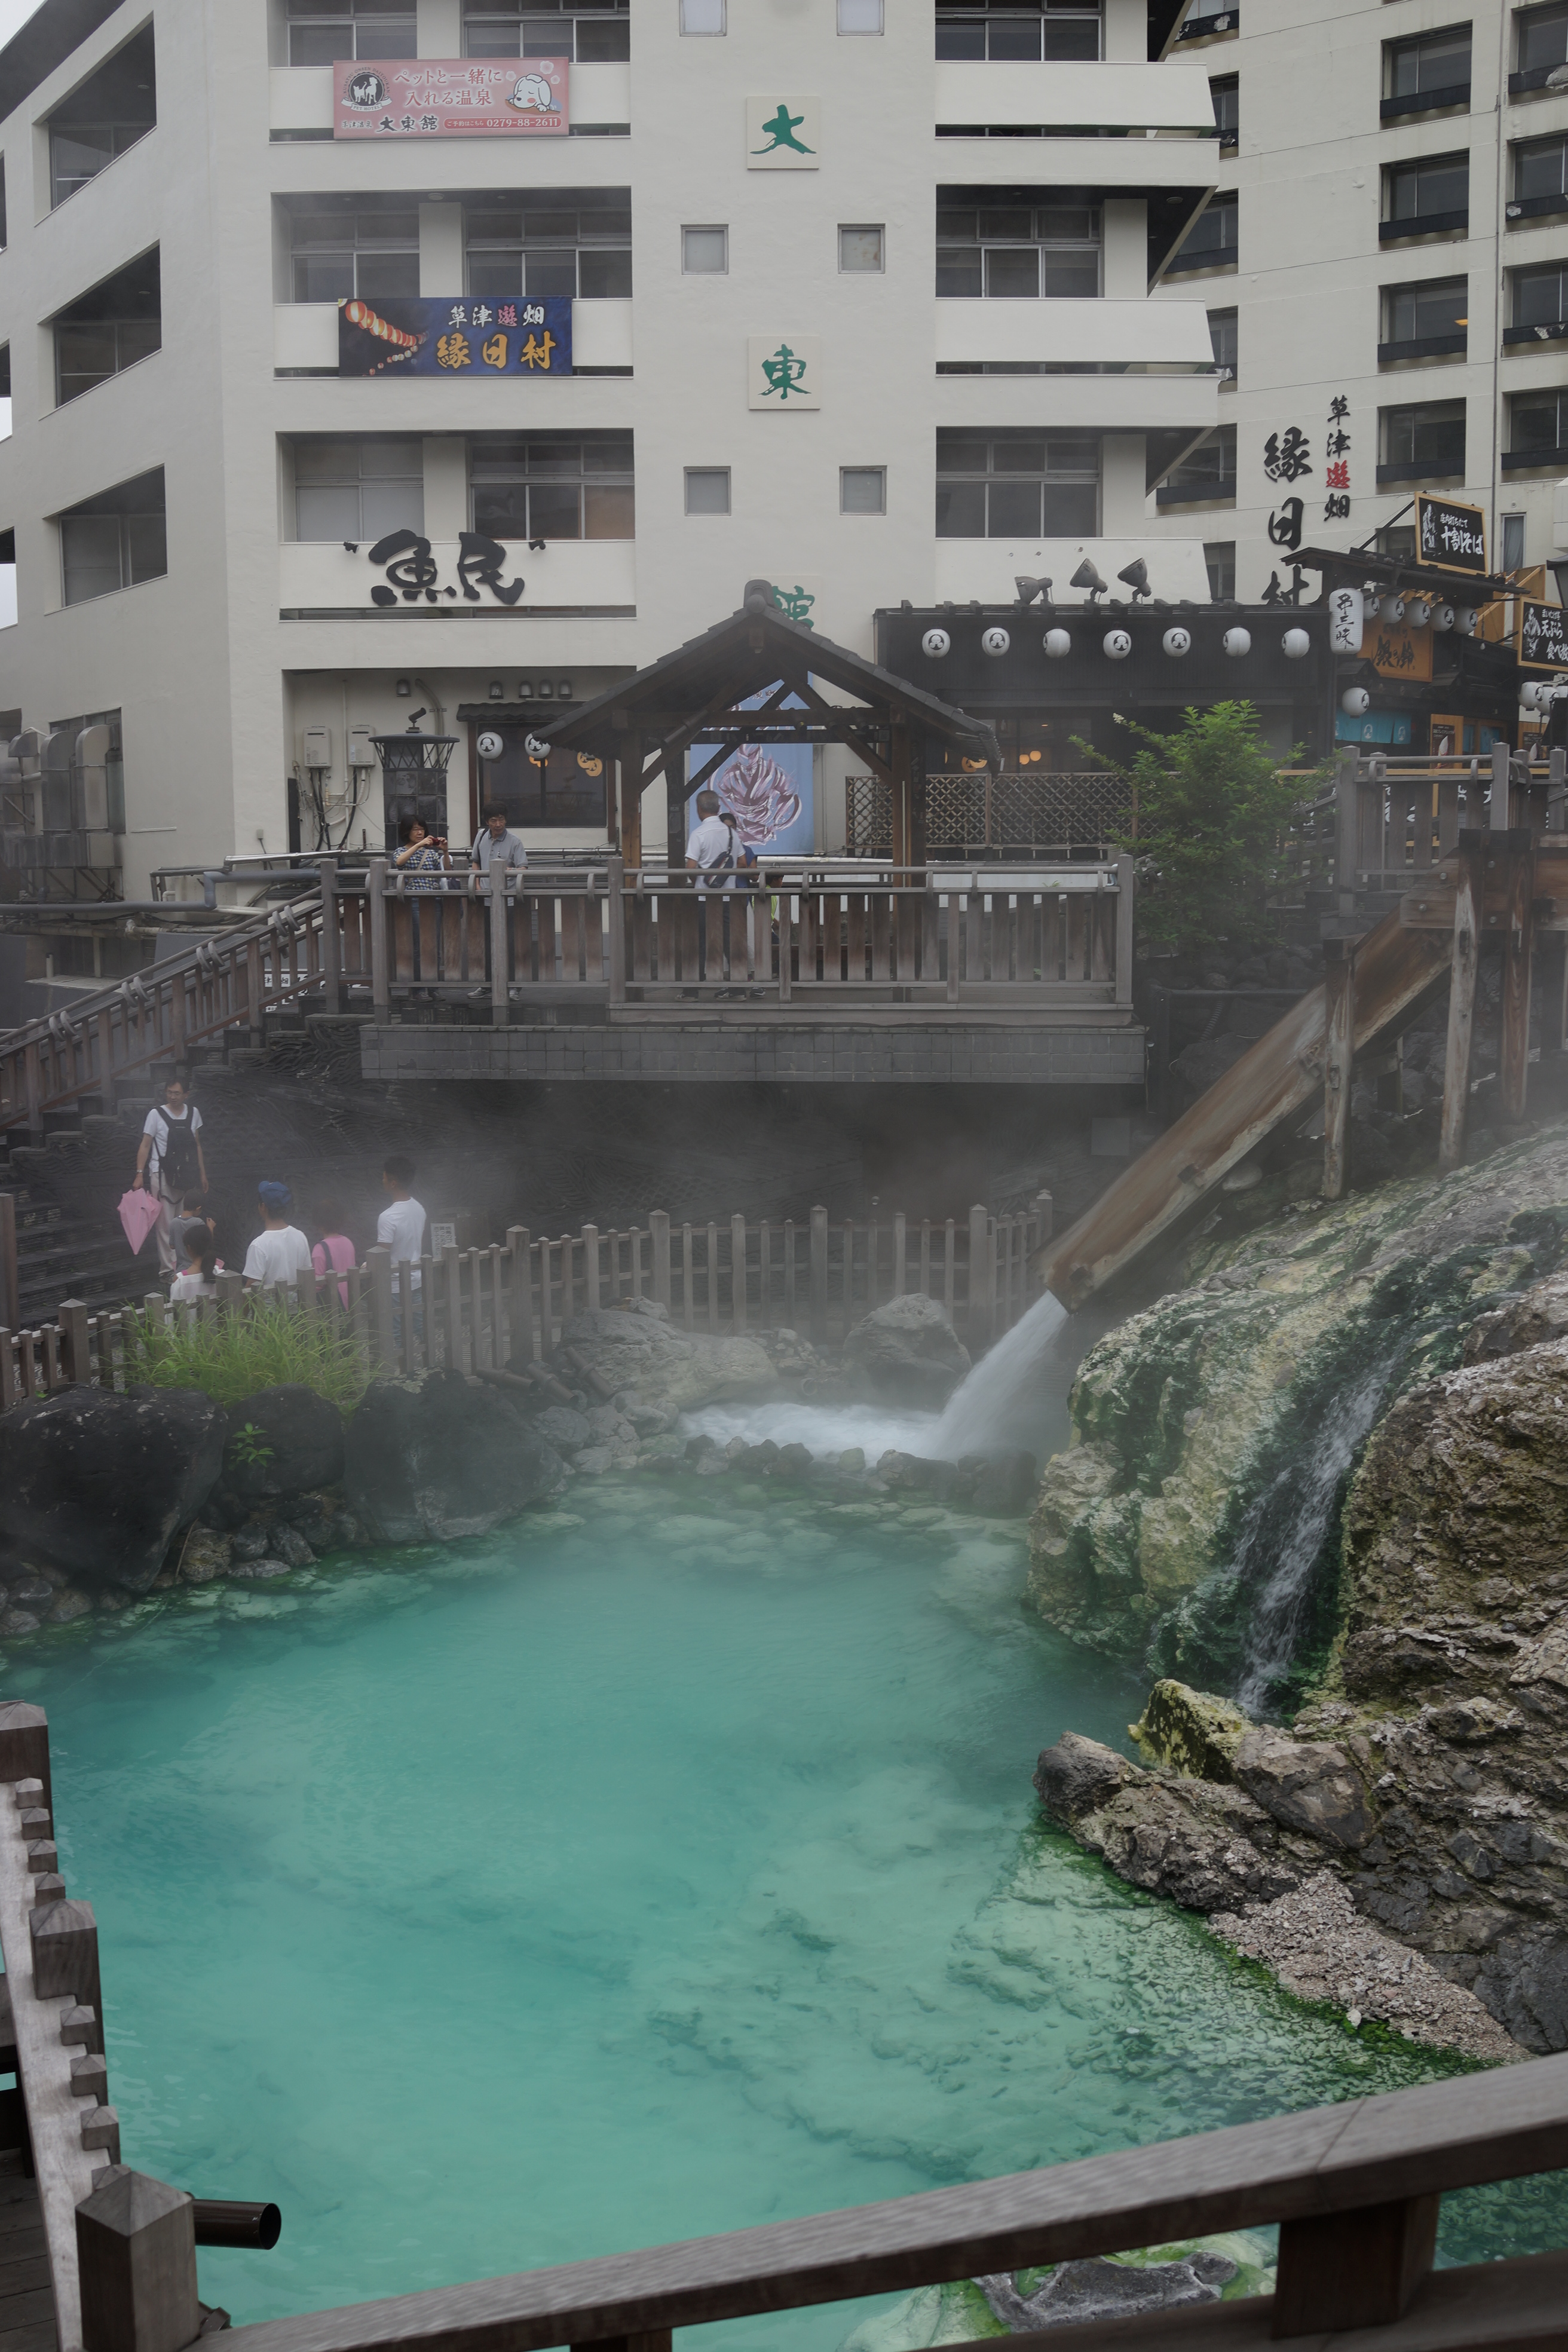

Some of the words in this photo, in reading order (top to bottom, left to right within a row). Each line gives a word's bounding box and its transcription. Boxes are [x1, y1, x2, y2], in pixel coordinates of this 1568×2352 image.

[343, 72, 354, 94] KUSATSU
[394, 68, 502, 85] ペットと一緒に
[406, 88, 493, 107] 入れる温泉
[486, 118, 559, 127] 0279-88-2611
[436, 331, 556, 369] 縁日村
[1261, 426, 1313, 606] 縁日村
[1441, 525, 1484, 555] 十割そば
[368, 529, 525, 607] 魚民
